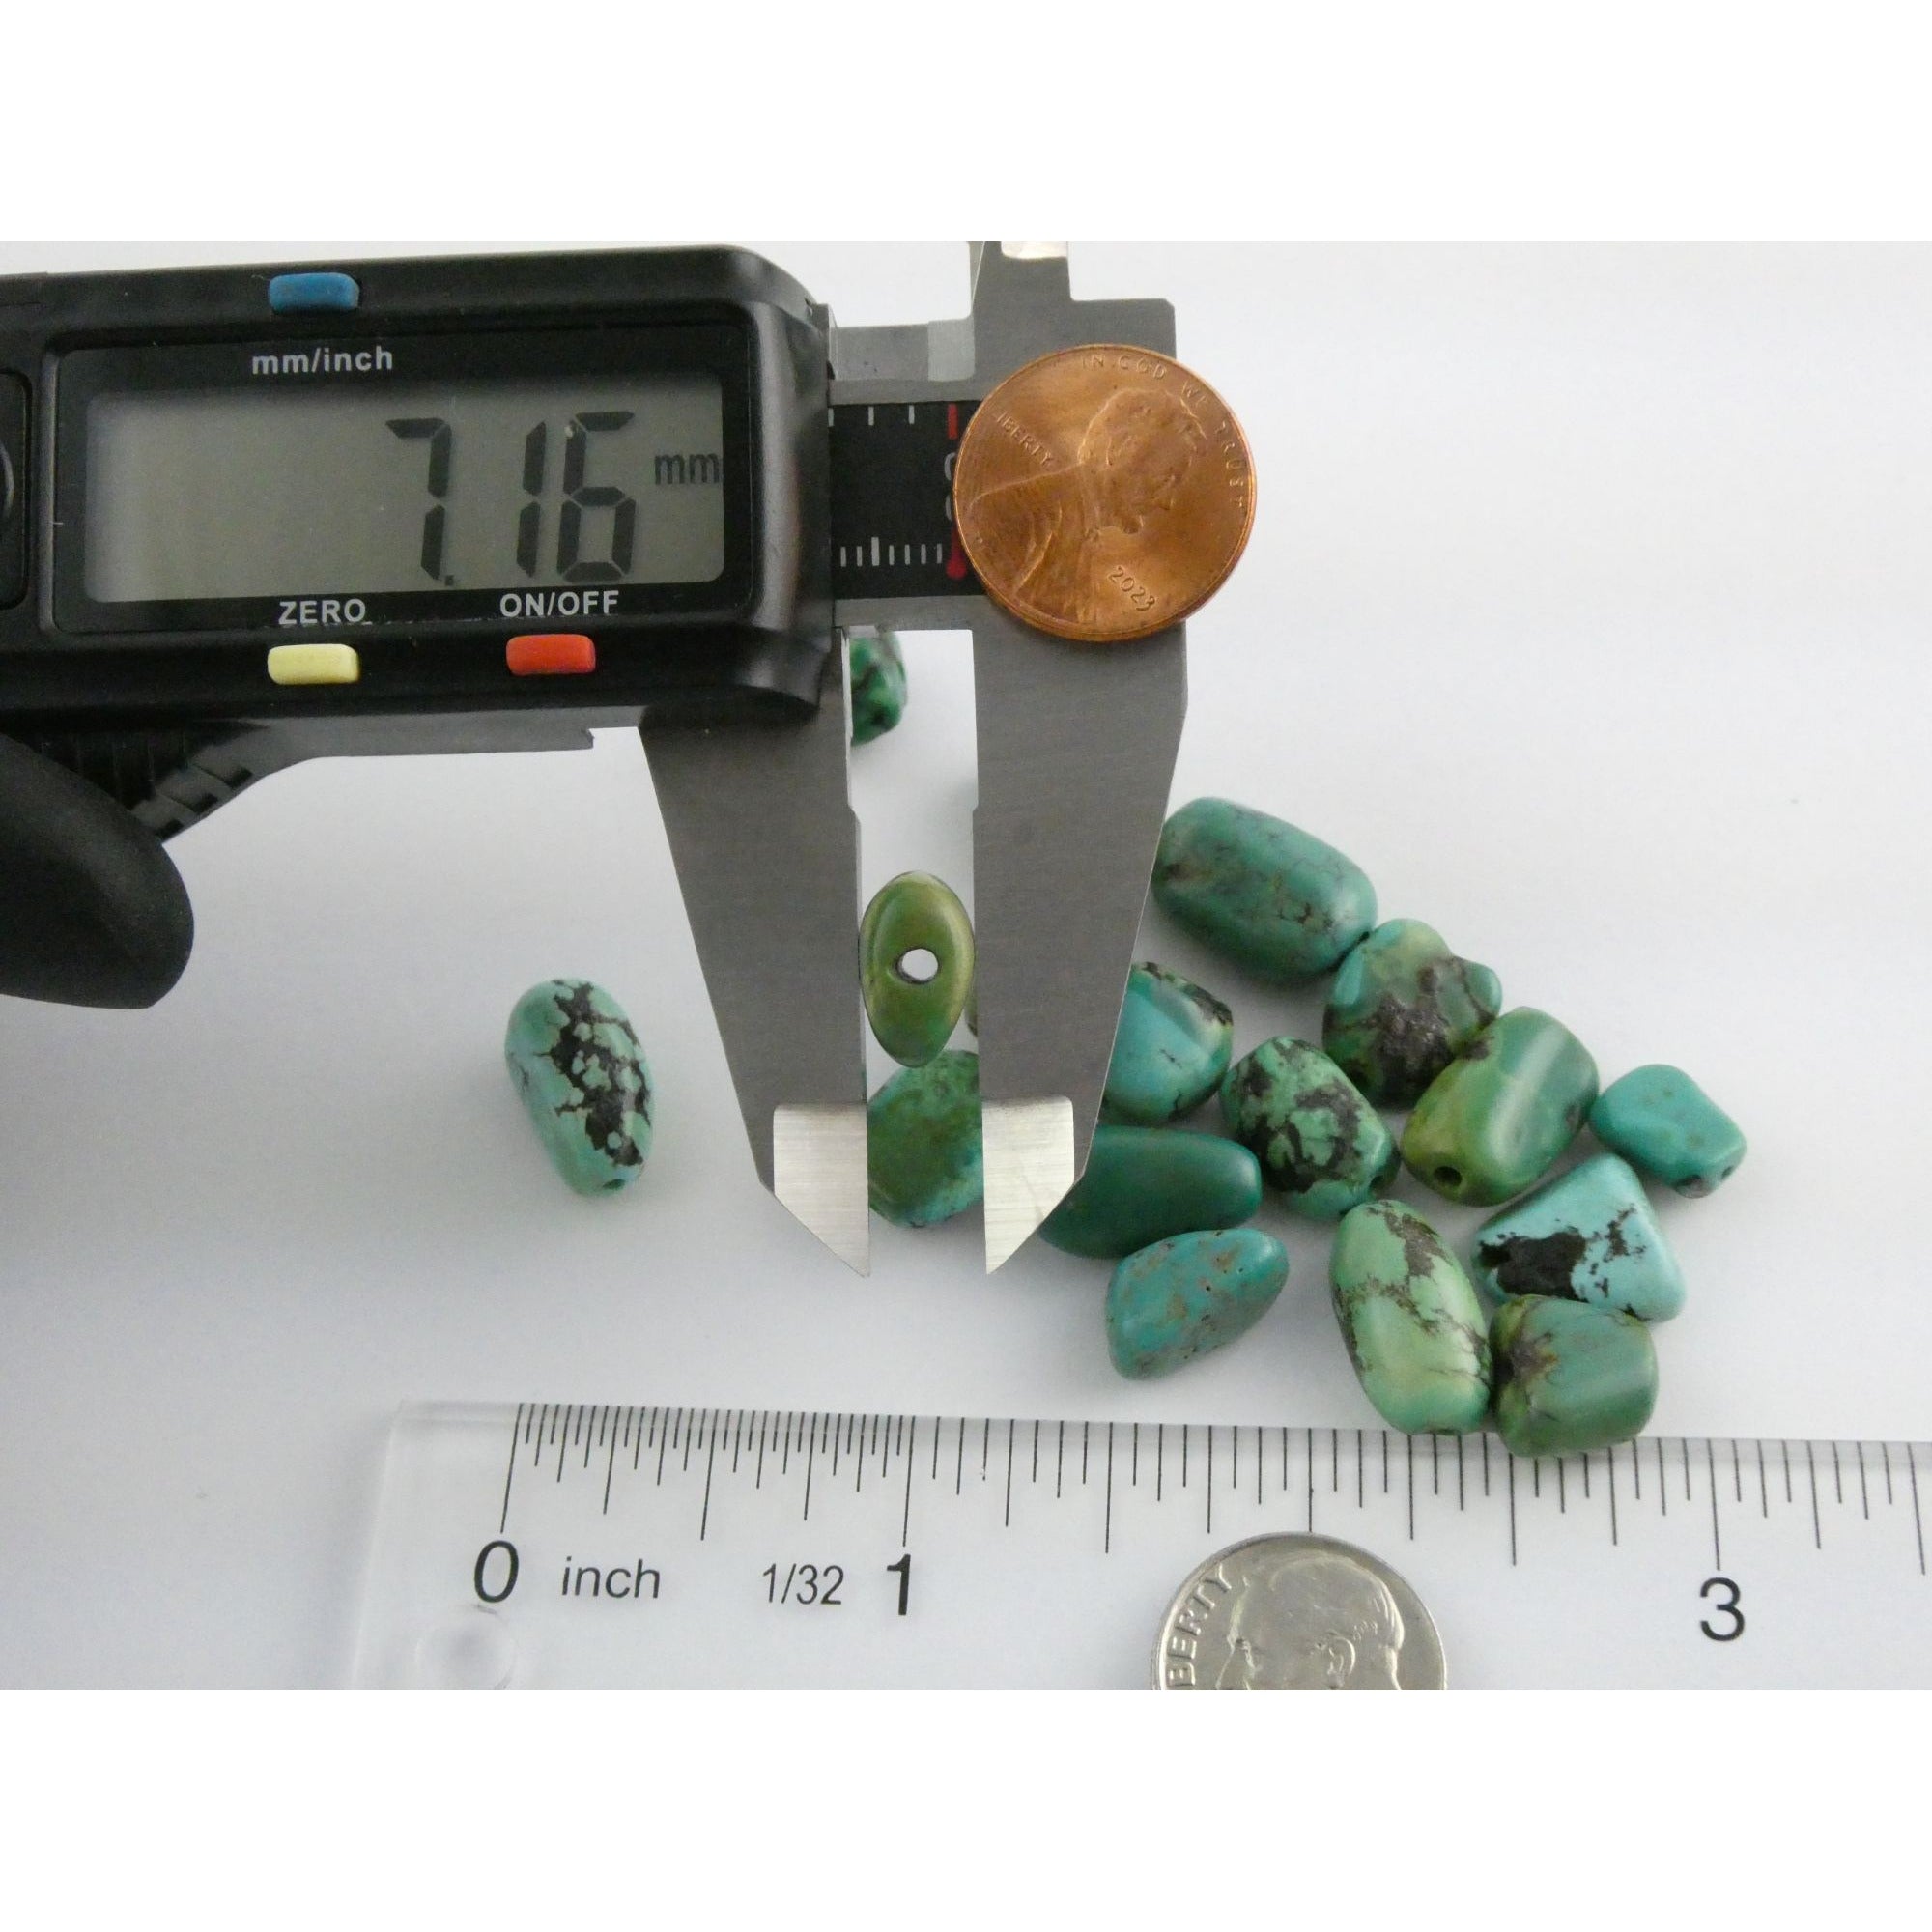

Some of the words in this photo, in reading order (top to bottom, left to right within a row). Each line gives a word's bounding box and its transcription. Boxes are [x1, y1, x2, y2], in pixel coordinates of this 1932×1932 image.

[251, 345, 393, 375] mm/inch
[1080, 354, 1106, 370] IN
[386, 410, 635, 586] 7.16
[654, 452, 721, 485] mm
[278, 599, 367, 625] ZERO
[499, 590, 619, 618] ON/OFF
[1108, 565, 1156, 612] 2023
[473, 1539, 520, 1604] 0
[561, 1556, 661, 1599] inch
[762, 1562, 845, 1605] 1/32
[886, 1553, 912, 1616] 1
[1699, 1577, 1745, 1642] 3
